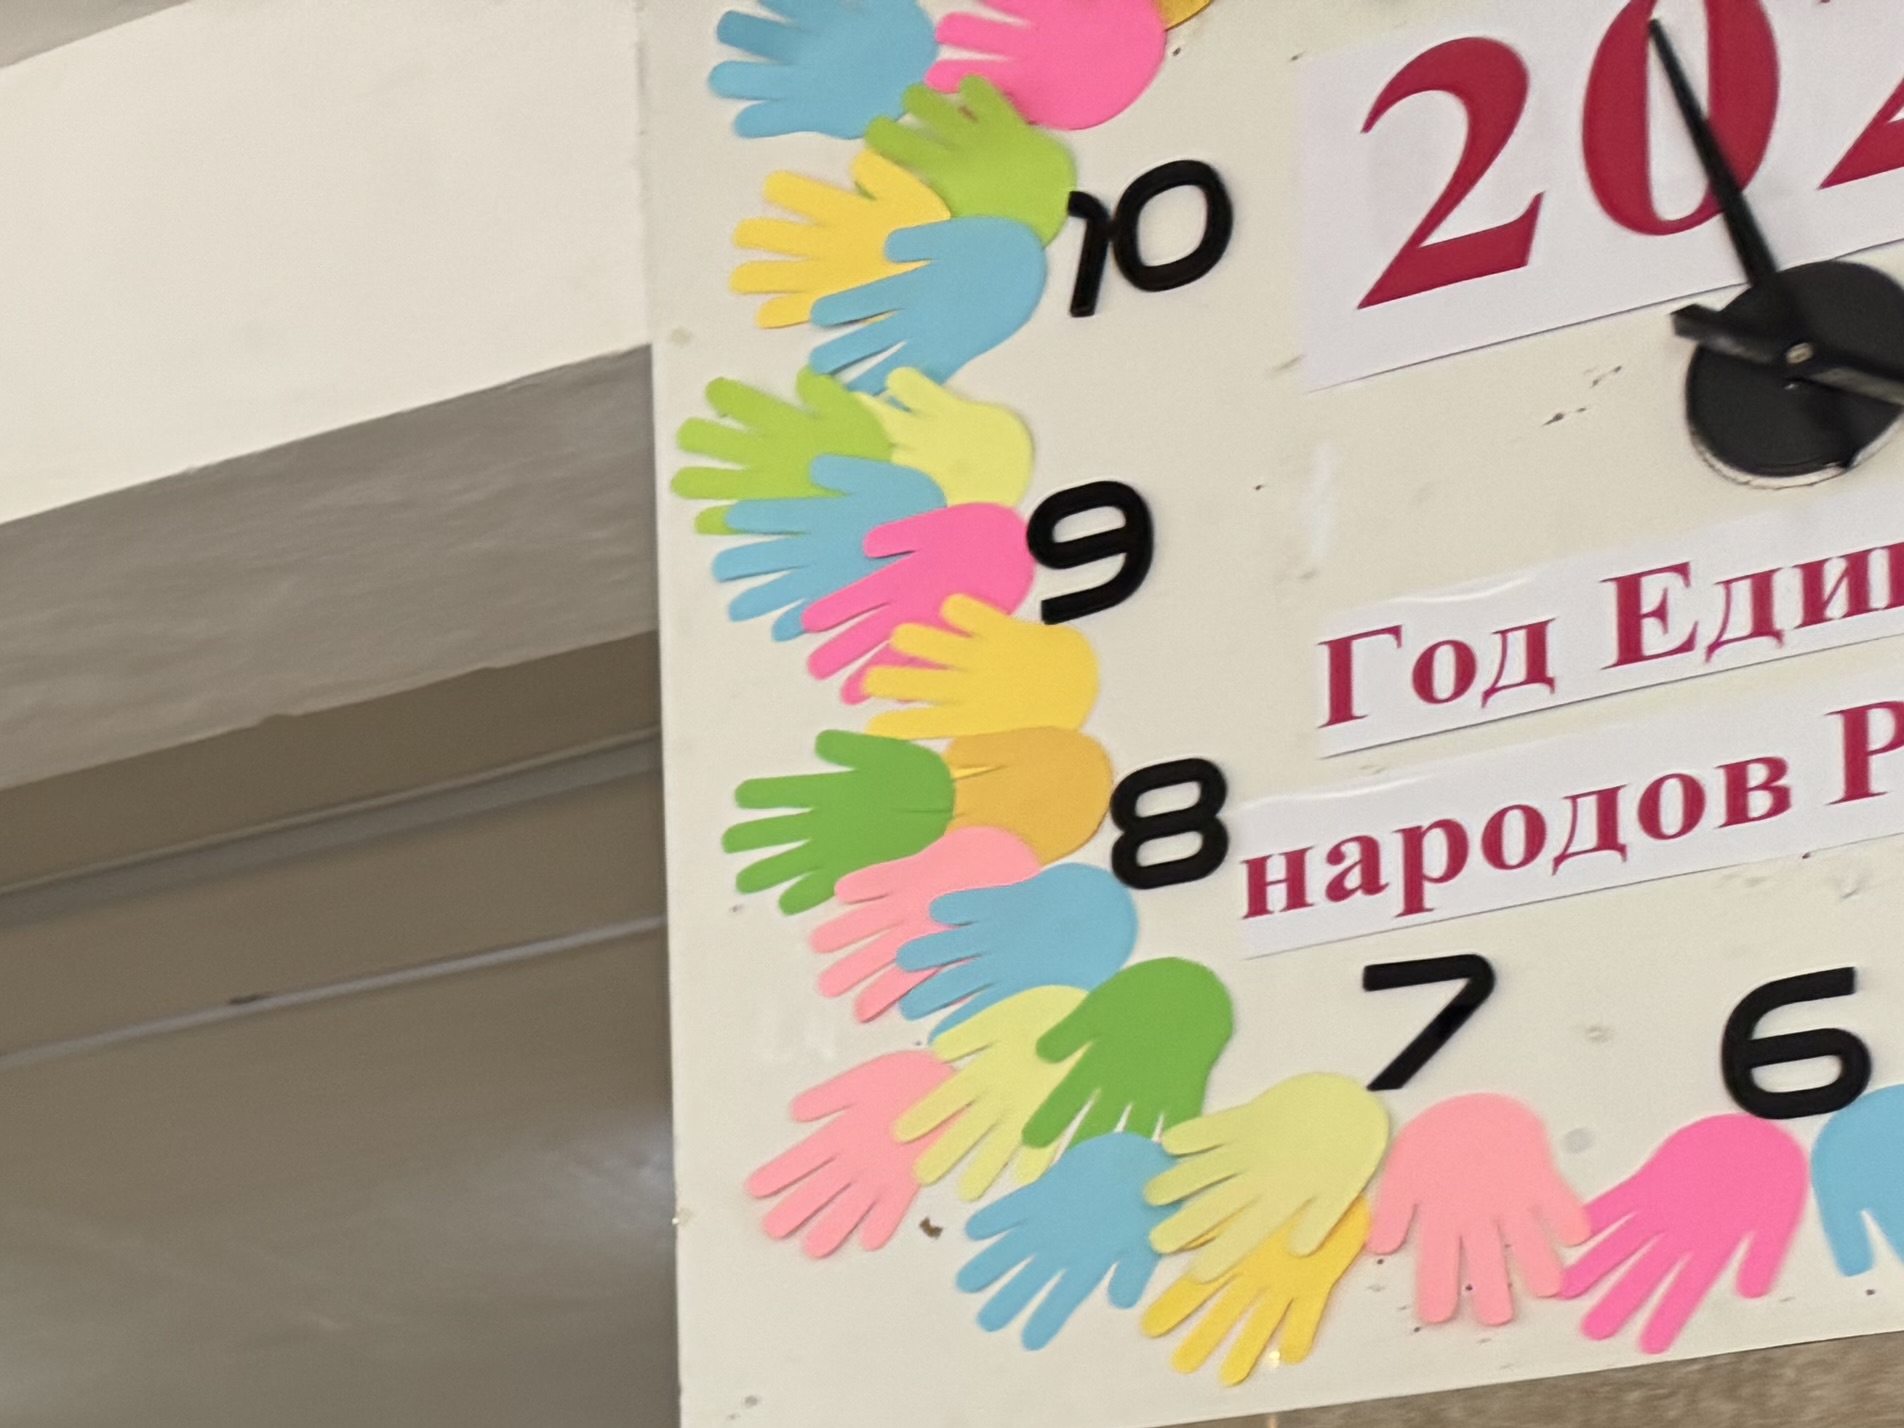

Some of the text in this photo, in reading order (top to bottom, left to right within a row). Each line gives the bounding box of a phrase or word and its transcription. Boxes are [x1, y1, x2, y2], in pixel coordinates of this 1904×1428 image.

[1067, 159, 1234, 318] 10
[1026, 480, 1154, 625] 9
[1318, 617, 1556, 730] Год
[1109, 757, 1230, 890] 8
[1240, 700, 1904, 921] народов Р
[1362, 953, 1497, 1092] 7
[1721, 966, 1872, 1121] 6
